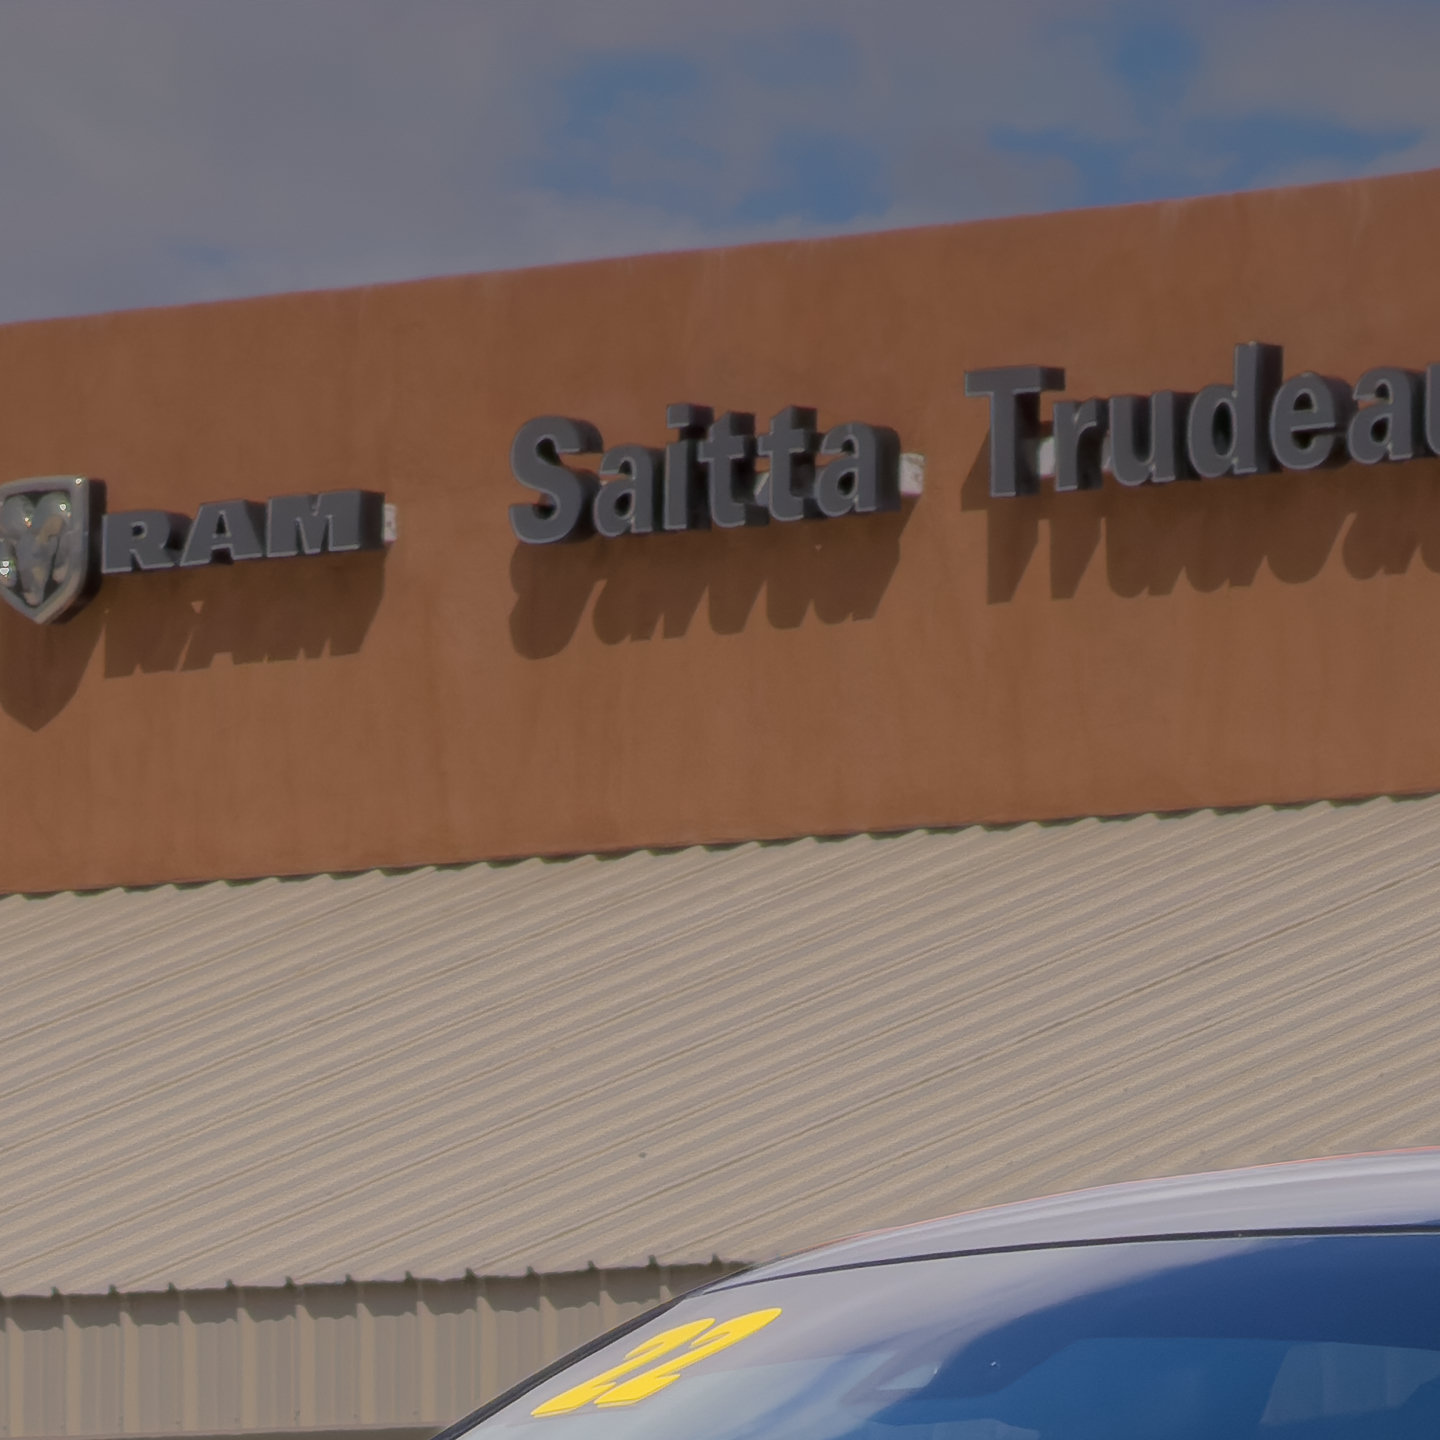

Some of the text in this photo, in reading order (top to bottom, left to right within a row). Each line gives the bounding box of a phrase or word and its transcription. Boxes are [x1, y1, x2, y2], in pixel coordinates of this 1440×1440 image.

[508, 402, 897, 545] Saitta
[100, 491, 372, 575] RAM
[530, 1307, 782, 1417] 22
